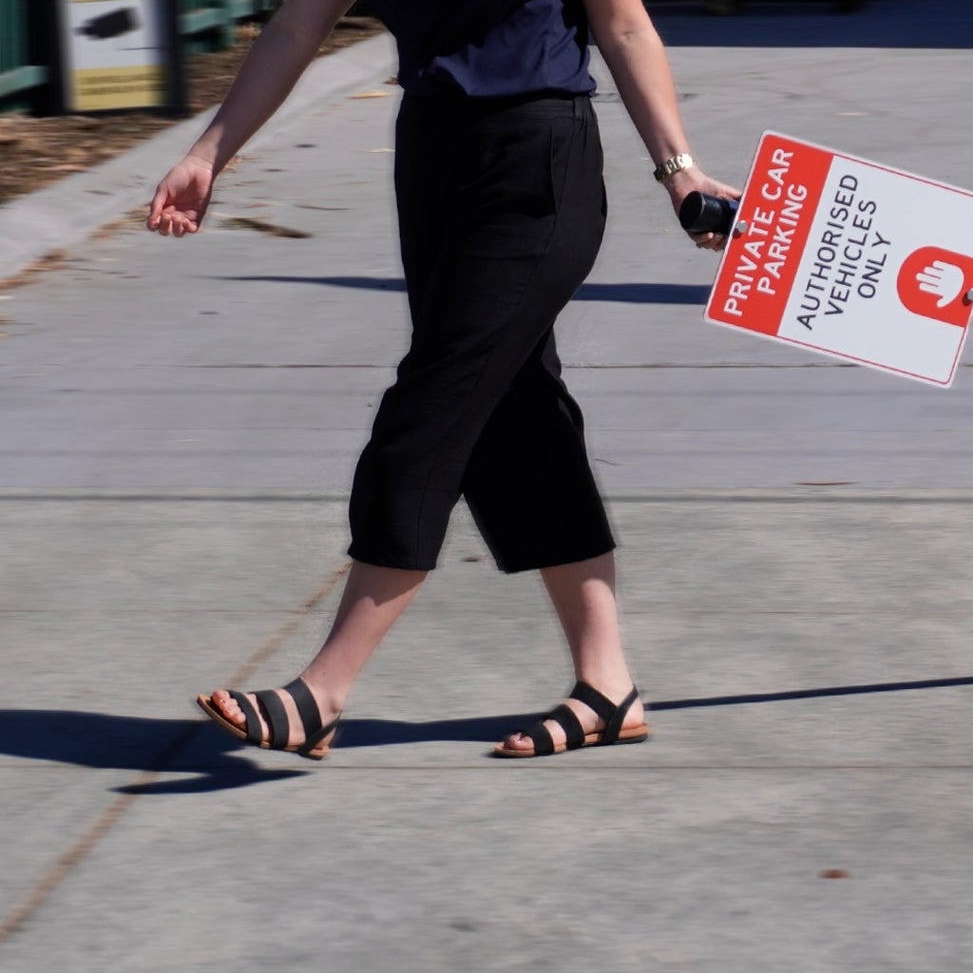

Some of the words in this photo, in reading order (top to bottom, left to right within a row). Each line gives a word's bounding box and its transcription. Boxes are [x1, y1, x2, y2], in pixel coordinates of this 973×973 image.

[724, 207, 775, 317] PRIVATE
[761, 148, 794, 201] CAR
[756, 184, 808, 295] PARKING
[796, 174, 858, 331] AUTHORISED
[824, 200, 877, 316] VEHICLES
[857, 231, 891, 299] ONLY
